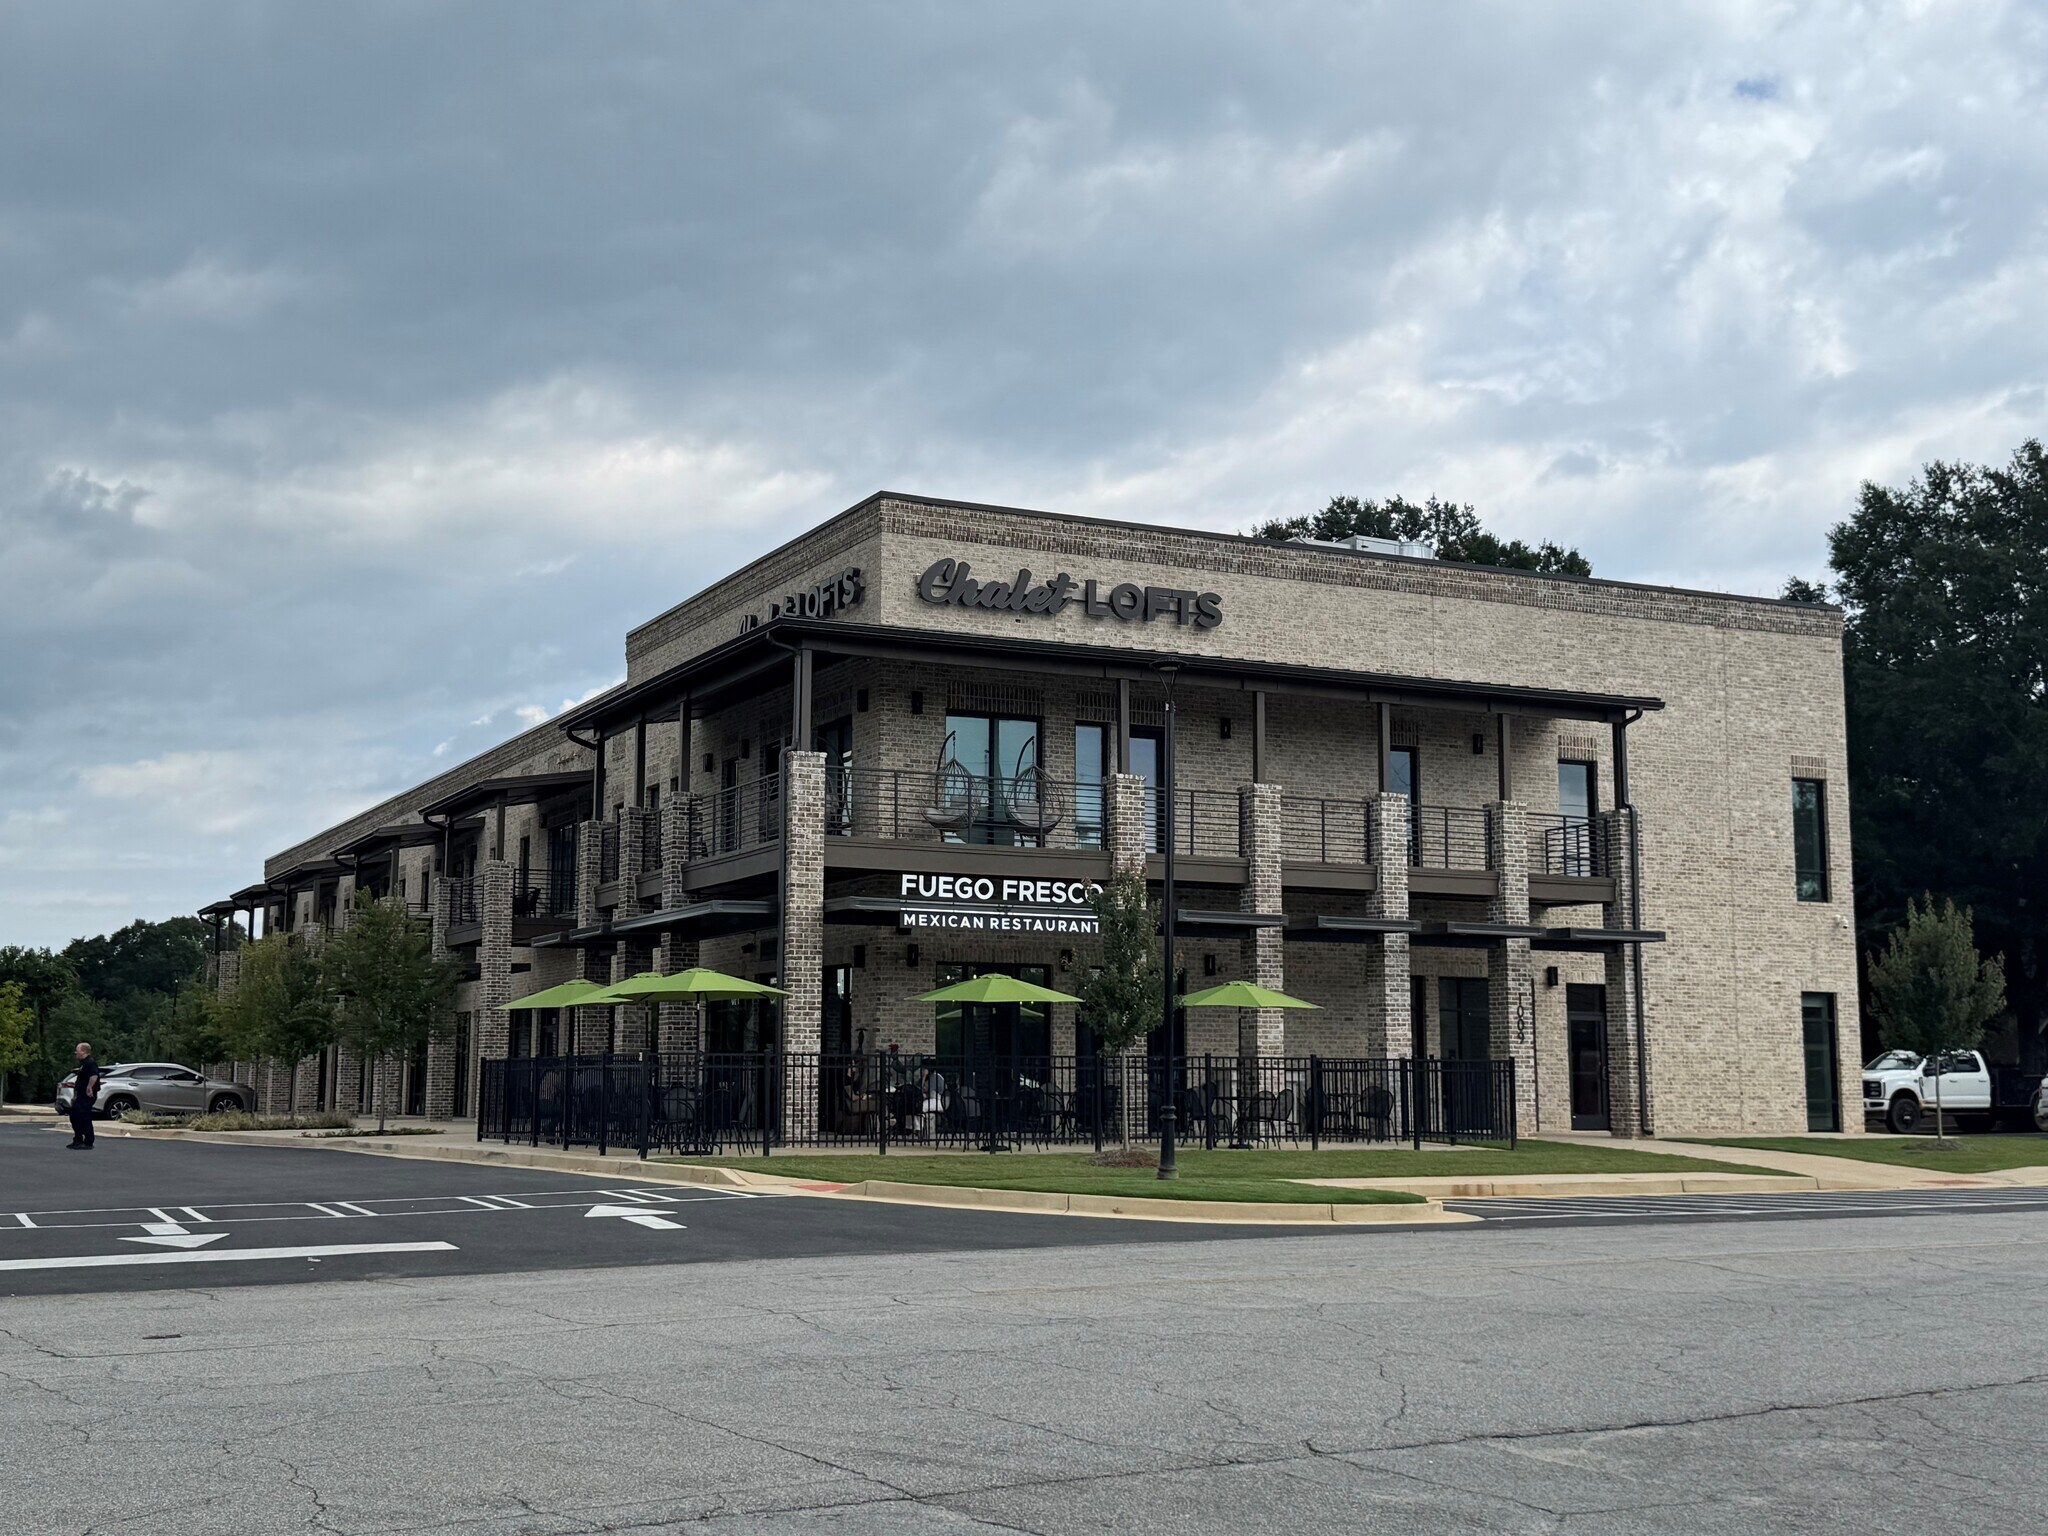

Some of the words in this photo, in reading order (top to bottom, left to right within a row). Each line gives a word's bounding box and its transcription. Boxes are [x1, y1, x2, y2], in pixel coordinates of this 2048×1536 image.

[919, 557, 1079, 614] Chalet
[1085, 578, 1223, 629] LOFTS
[901, 874, 994, 900] FUEGO
[903, 914, 984, 929] MEXICAN
[990, 918, 1099, 934] RESTAURANT
[1516, 992, 1525, 1044] 1009
